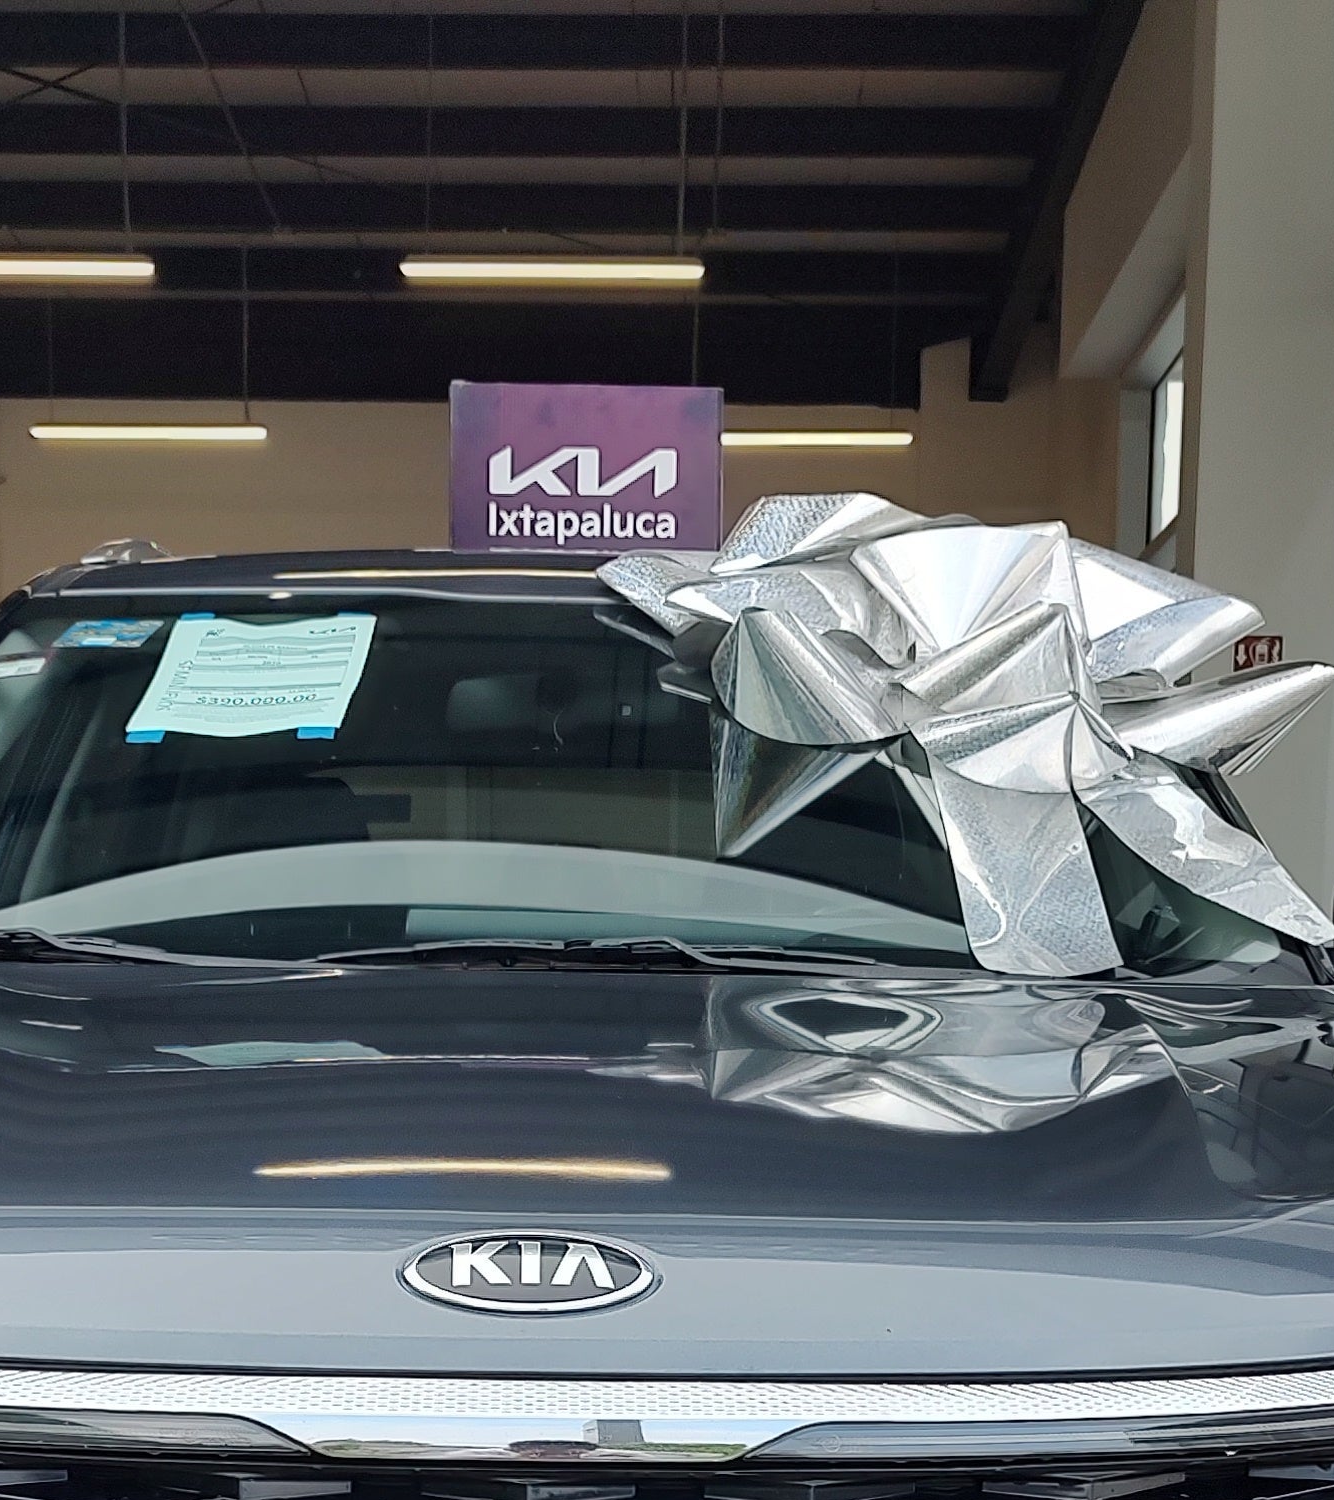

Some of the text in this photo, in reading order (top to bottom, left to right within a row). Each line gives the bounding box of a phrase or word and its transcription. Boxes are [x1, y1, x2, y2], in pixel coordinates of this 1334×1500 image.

[487, 445, 677, 498] KIA
[487, 501, 677, 545] Ixtapaluca
[449, 1240, 615, 1288] KIA
